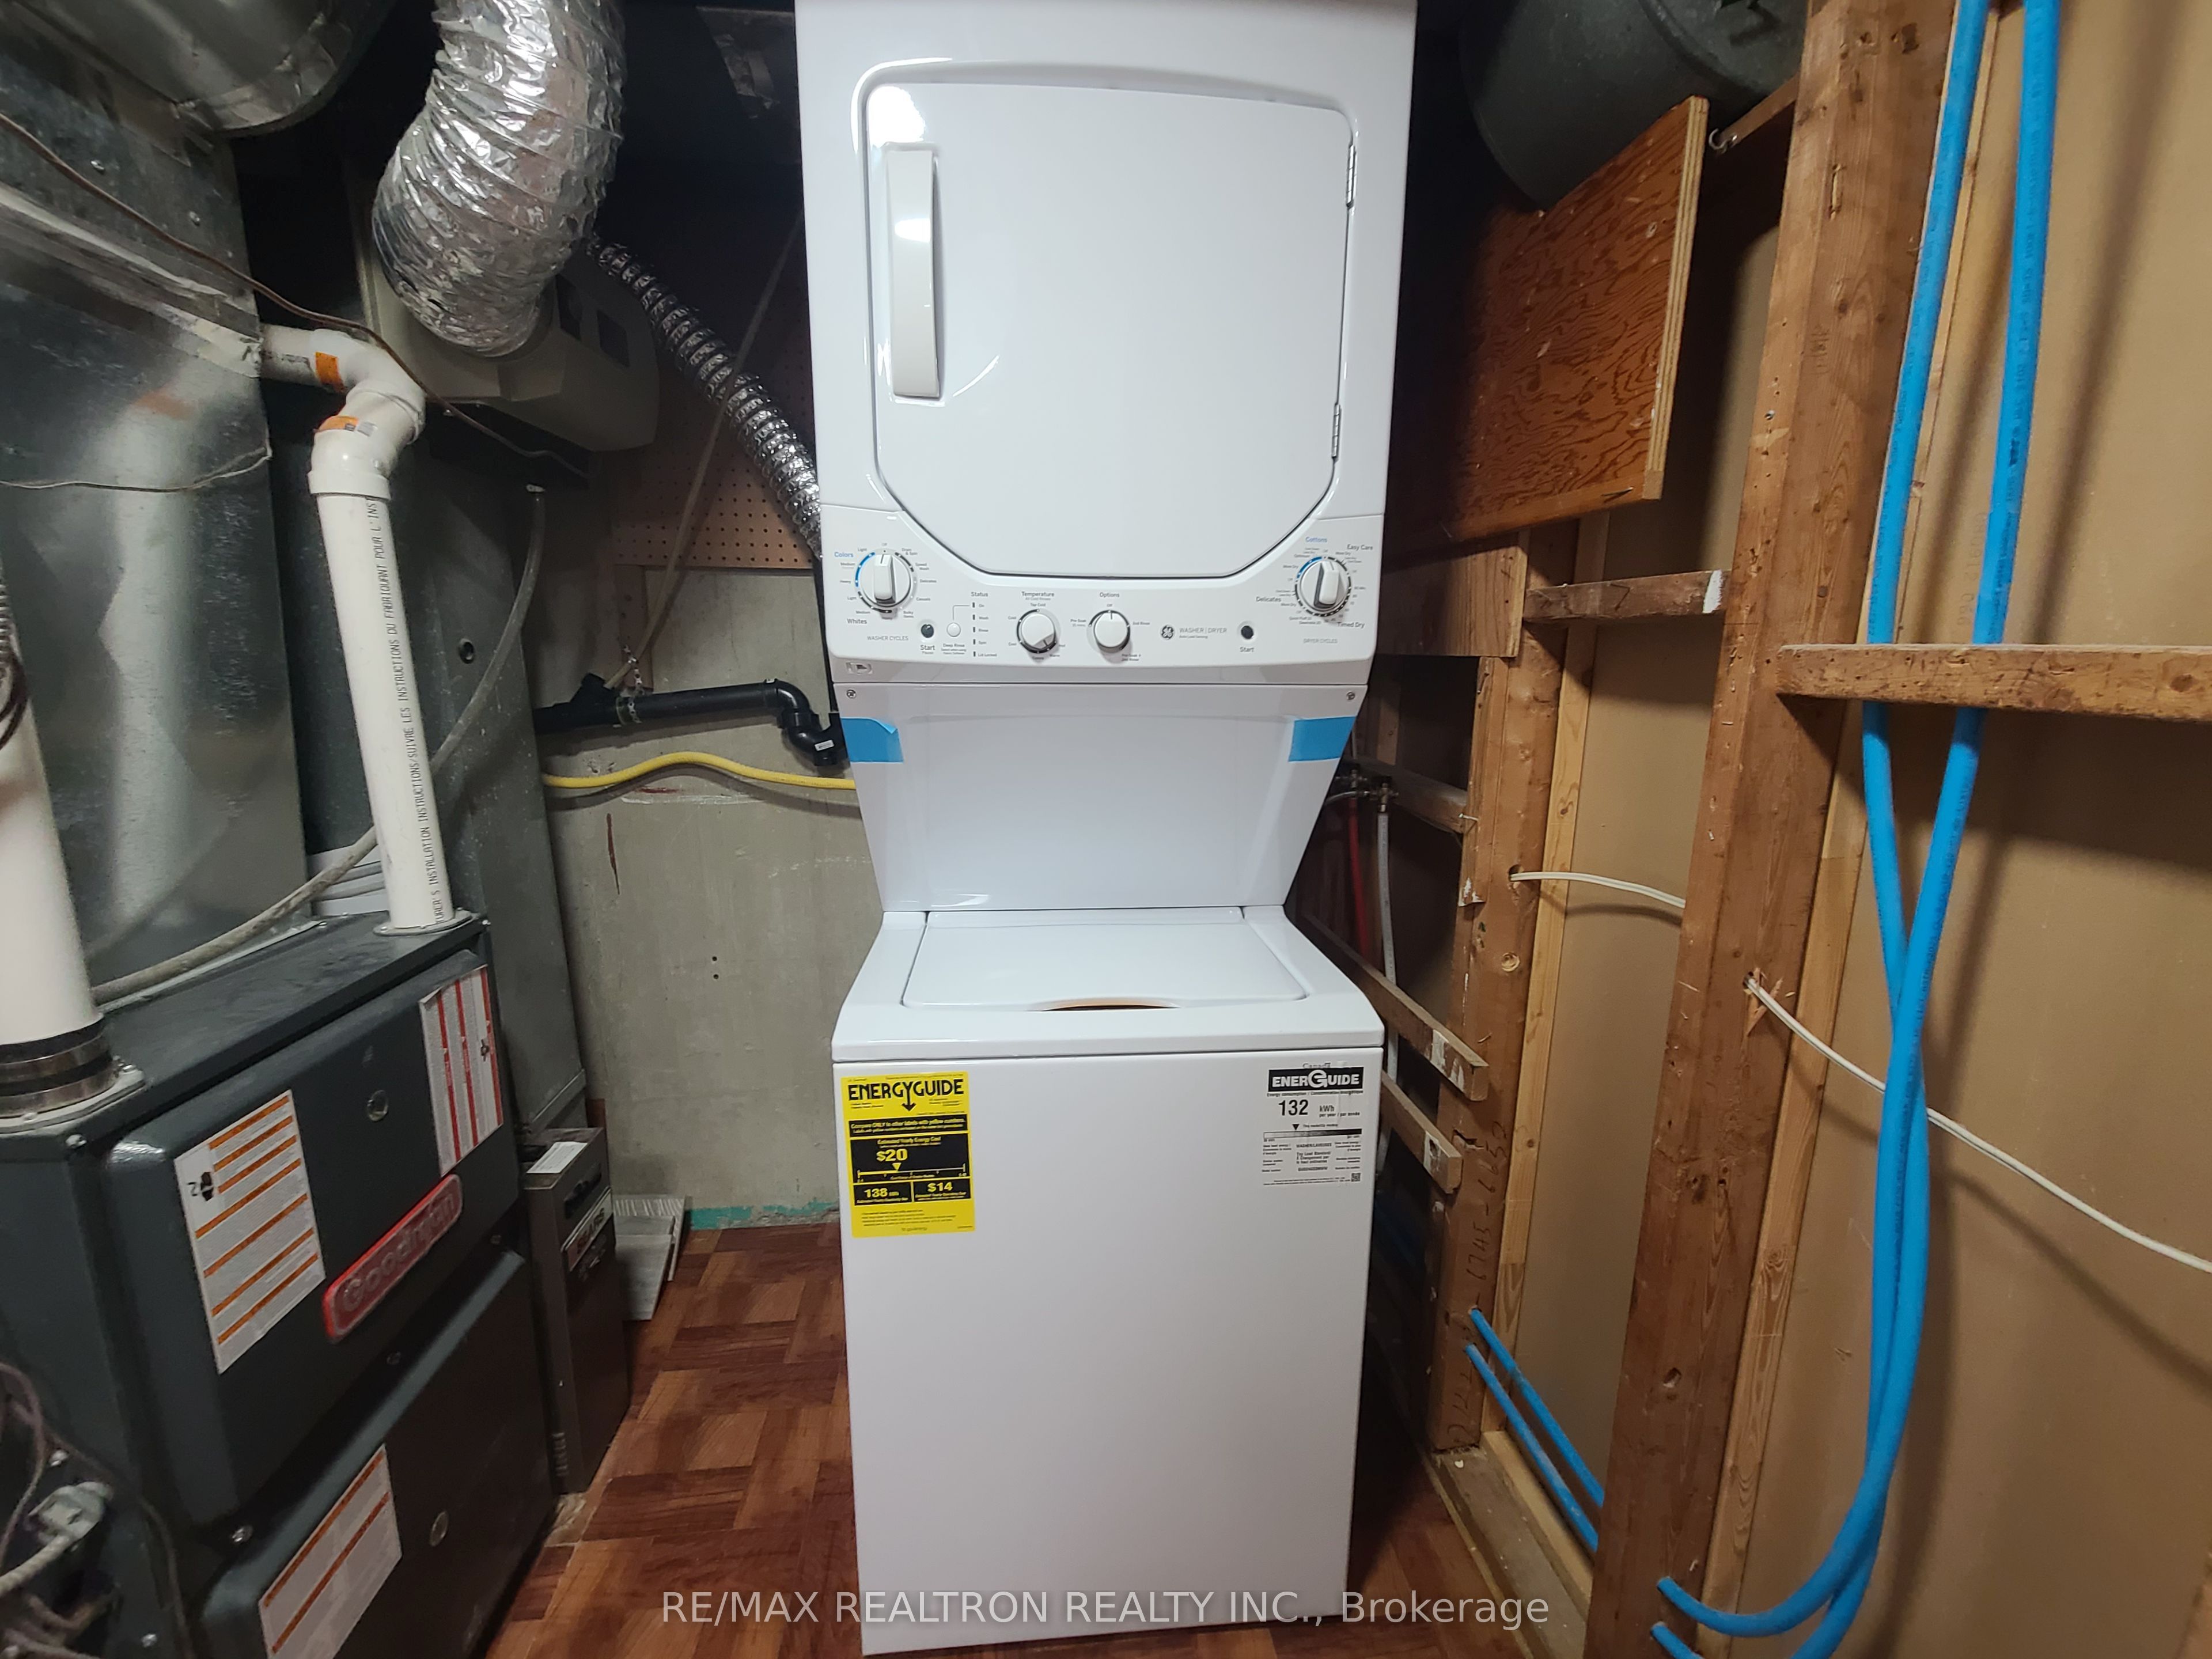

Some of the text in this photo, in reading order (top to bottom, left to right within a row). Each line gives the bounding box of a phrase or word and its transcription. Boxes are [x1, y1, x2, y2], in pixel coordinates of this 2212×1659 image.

[372, 536, 385, 559] POUR
[386, 623, 397, 635] DU
[389, 639, 408, 701] INSTRUCTIONS
[400, 707, 412, 723] LES
[404, 728, 428, 821] INSTRUCTIONS/SUIVRE
[421, 827, 438, 885] INSTALLATION
[1272, 1069, 1359, 1088] ENERGUIDE
[848, 1079, 964, 1101] ENERGYGUIDE
[1278, 1099, 1309, 1116] 132
[876, 1148, 908, 1161] $20
[864, 1188, 888, 1198] 138
[927, 1182, 953, 1192] $14
[343, 1194, 454, 1312] Goodman
